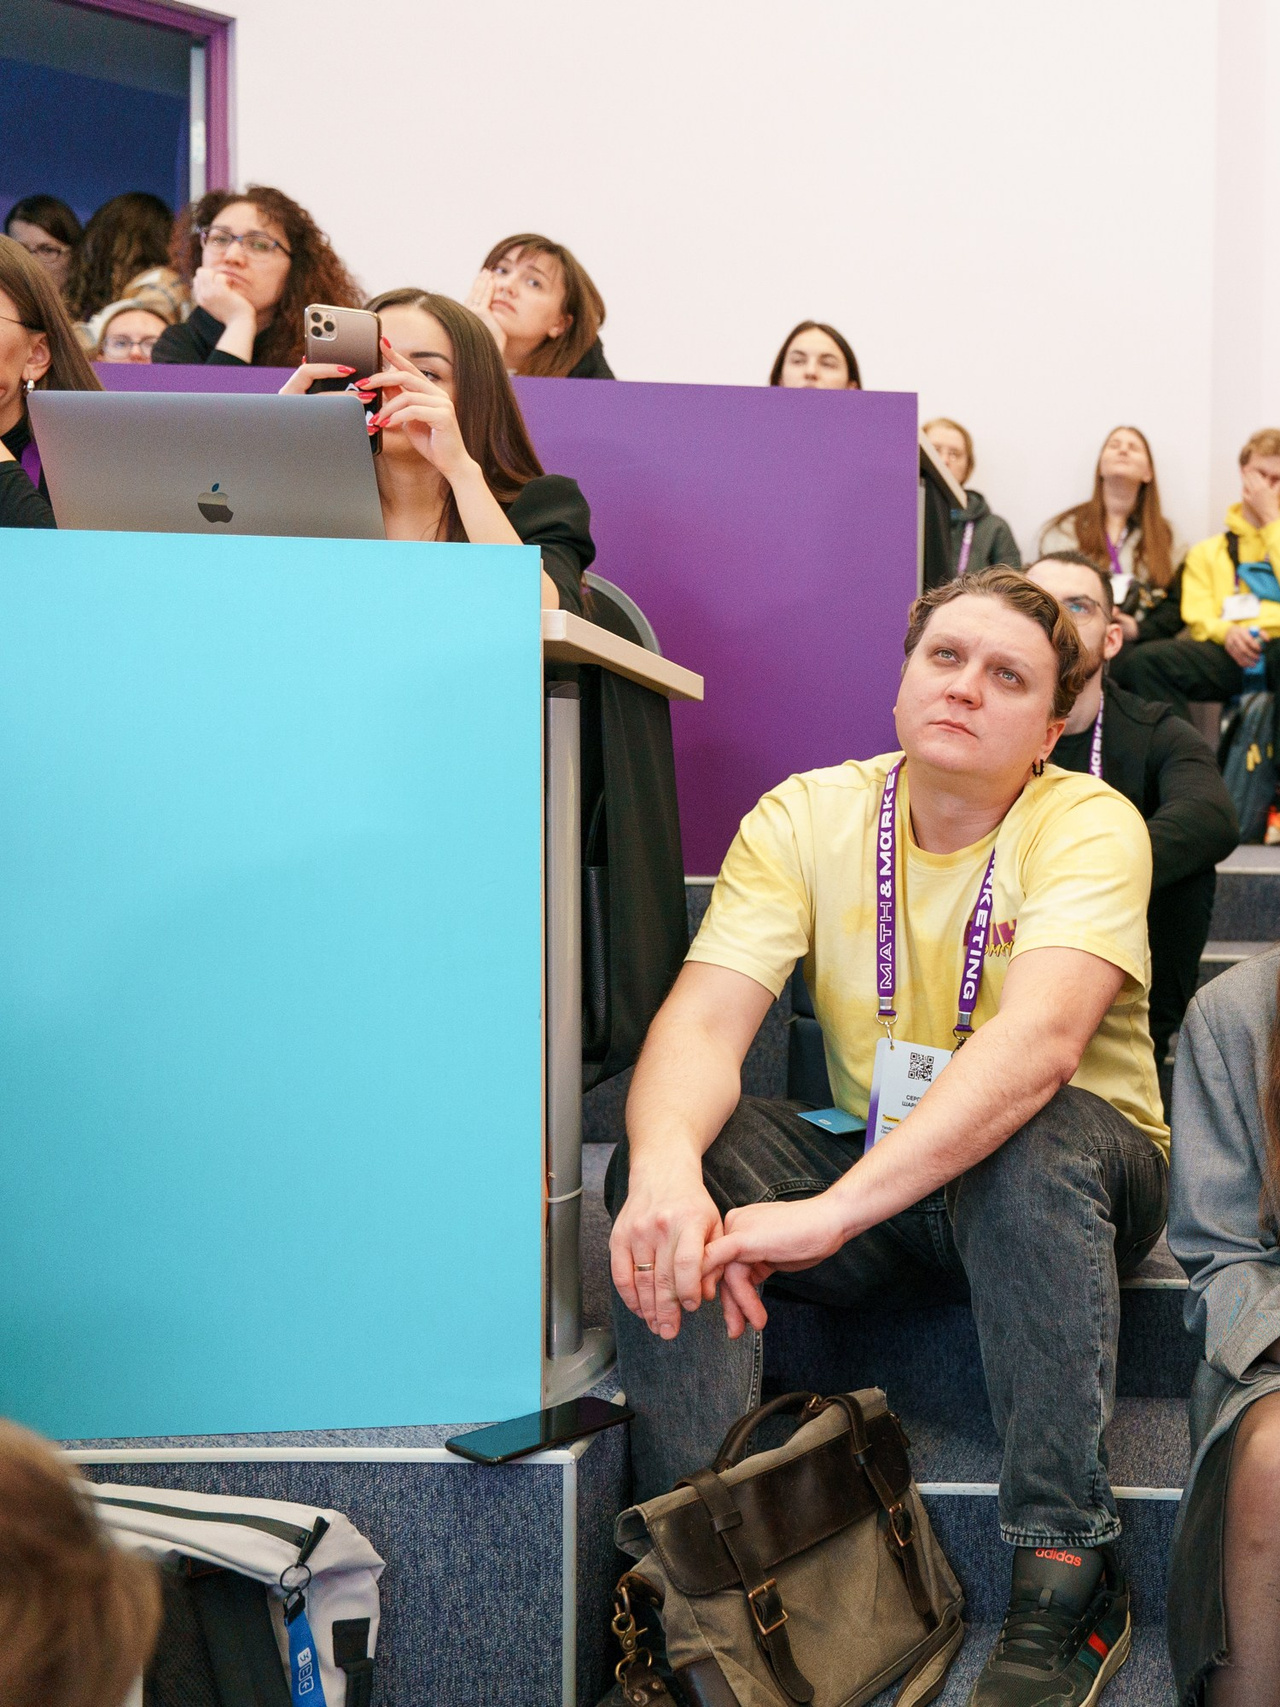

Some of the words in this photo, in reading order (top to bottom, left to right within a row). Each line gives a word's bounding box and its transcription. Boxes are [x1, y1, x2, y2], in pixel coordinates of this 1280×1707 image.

[880, 766, 897, 876] MARKE
[880, 879, 892, 898] &
[880, 901, 892, 989] MATH
[1035, 1547, 1082, 1567] adidas
